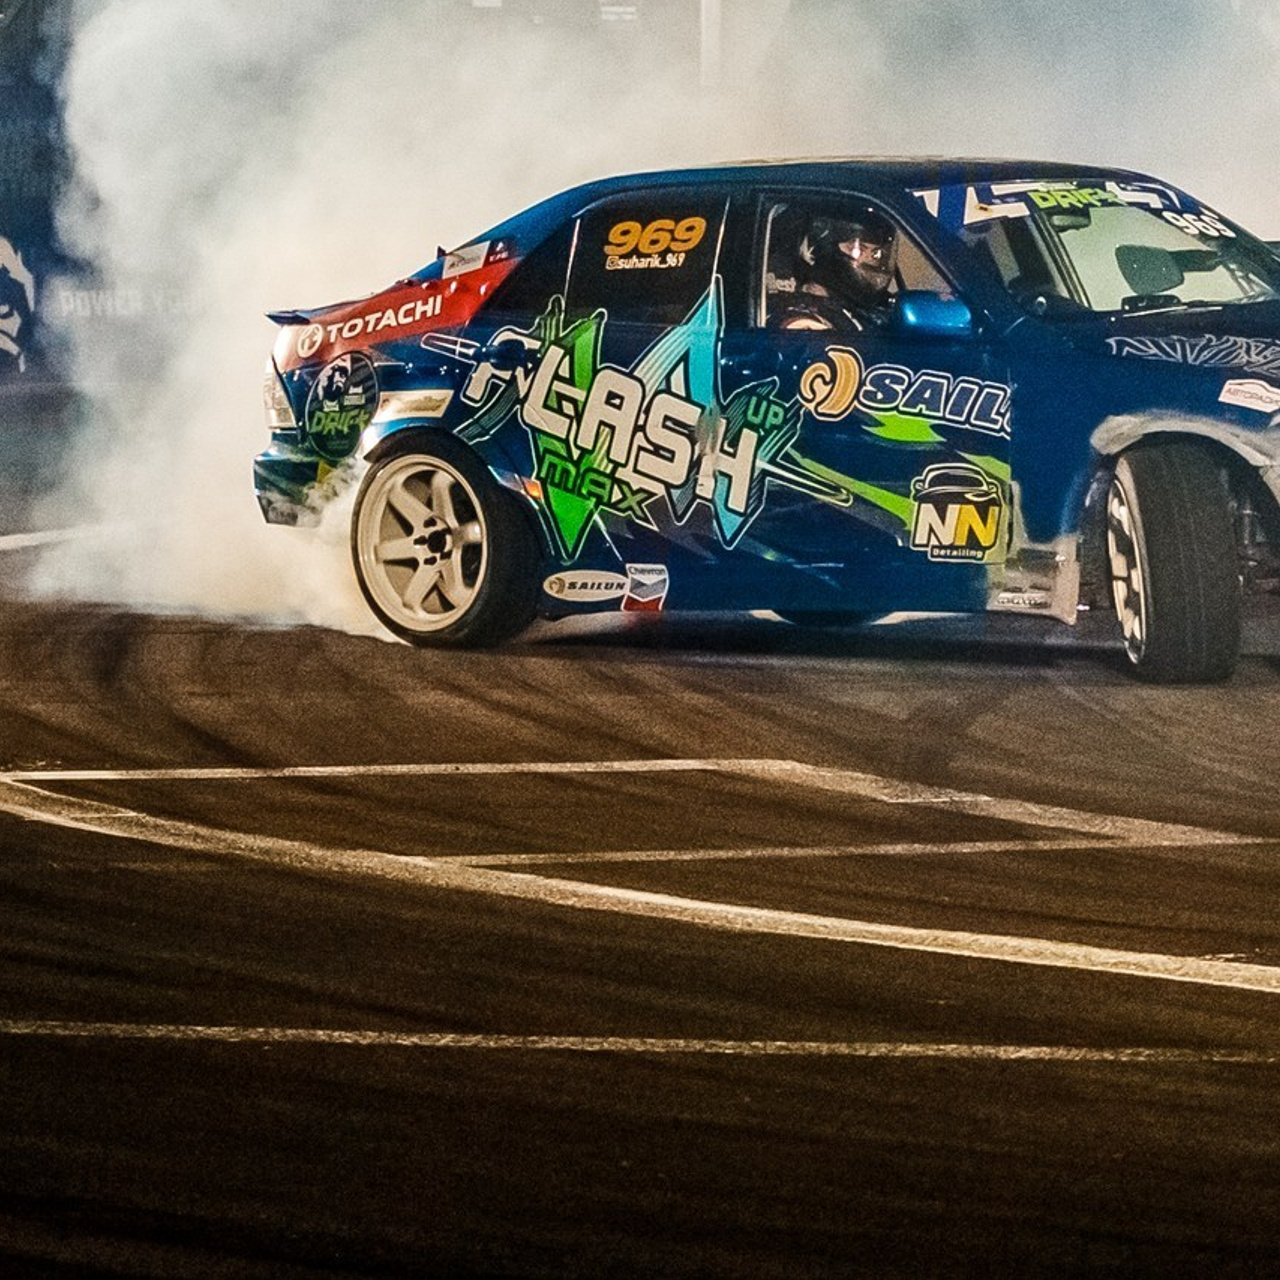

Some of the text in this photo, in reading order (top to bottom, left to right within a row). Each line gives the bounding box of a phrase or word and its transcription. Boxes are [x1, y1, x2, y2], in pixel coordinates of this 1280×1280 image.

[603, 216, 707, 255] 969
[326, 294, 443, 343] TOTACHI
[747, 395, 786, 431] UP
[858, 368, 1011, 436] SAIL
[540, 451, 649, 517] MAX
[914, 503, 1000, 547] NN
[628, 566, 667, 577] Chevron
[932, 548, 984, 559] Detailing
[567, 581, 626, 591] SAILUN
